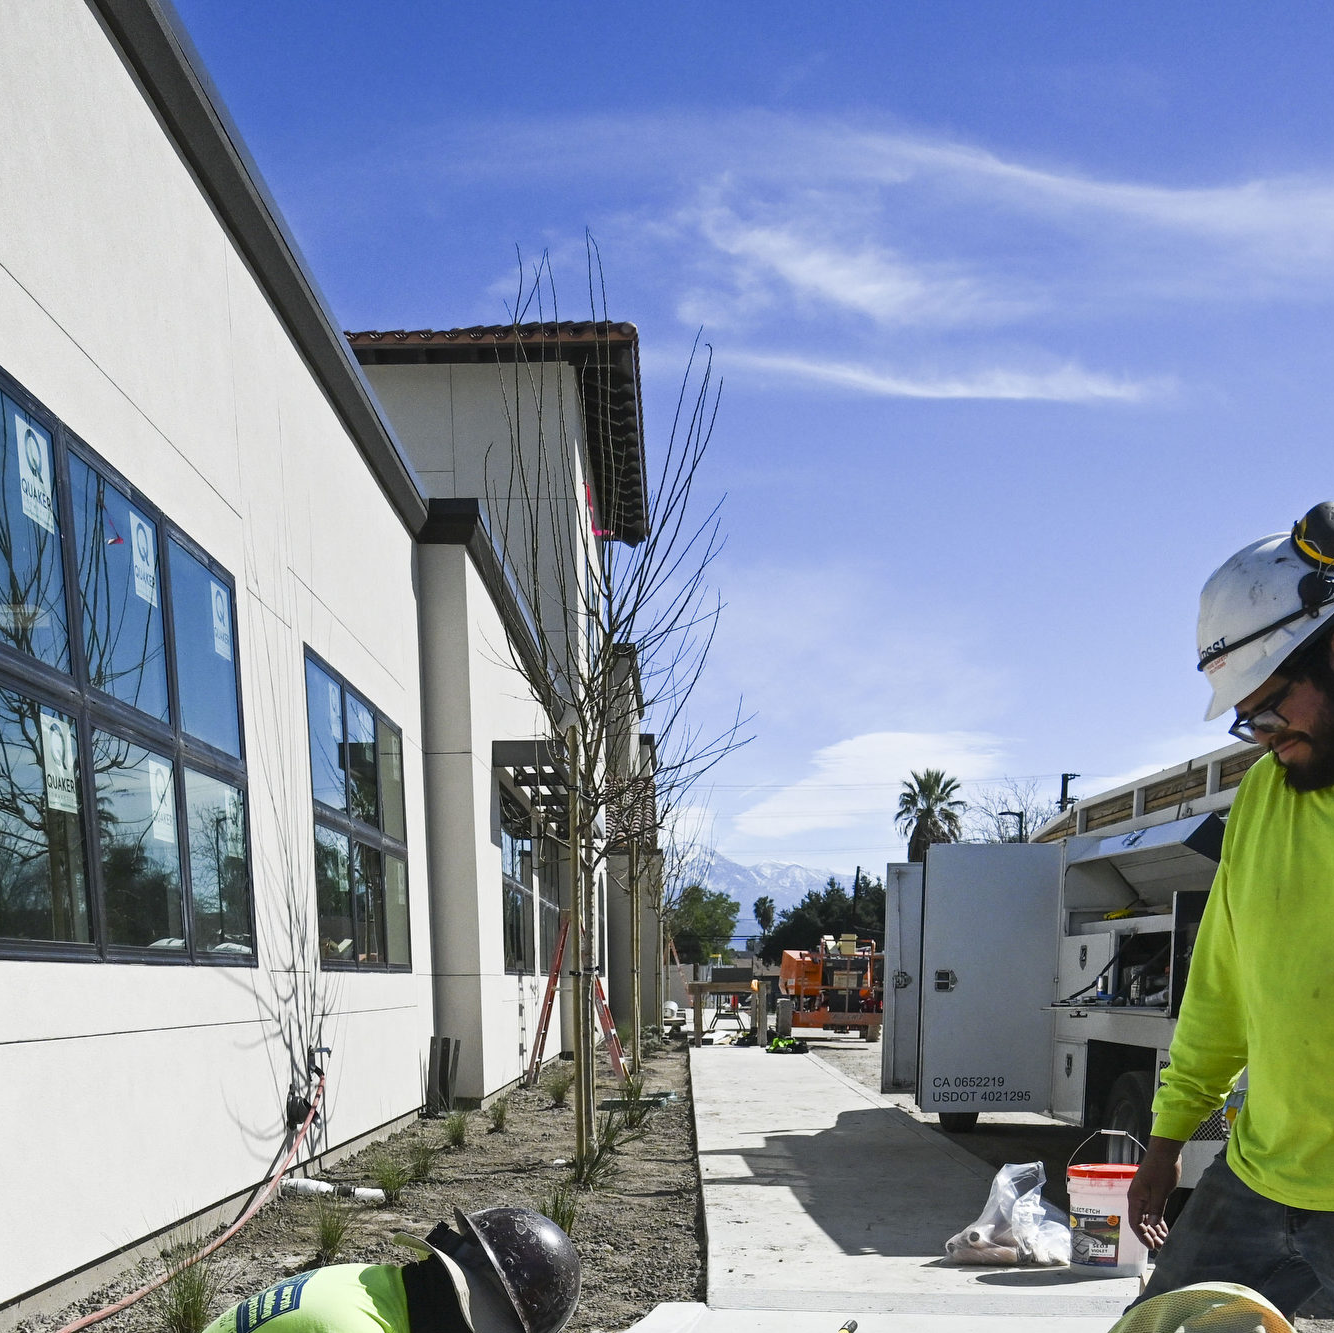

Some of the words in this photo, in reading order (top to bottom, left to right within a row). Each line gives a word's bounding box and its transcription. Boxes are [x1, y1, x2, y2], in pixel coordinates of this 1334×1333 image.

[21, 478, 52, 512] QUAKER
[134, 565, 155, 588] QUAKER
[47, 773, 76, 795] QUAKER
[933, 1077, 951, 1088] CA
[954, 1076, 1005, 1088] 0652219
[932, 1091, 978, 1103] USDOT
[980, 1090, 1031, 1102] 4021295
